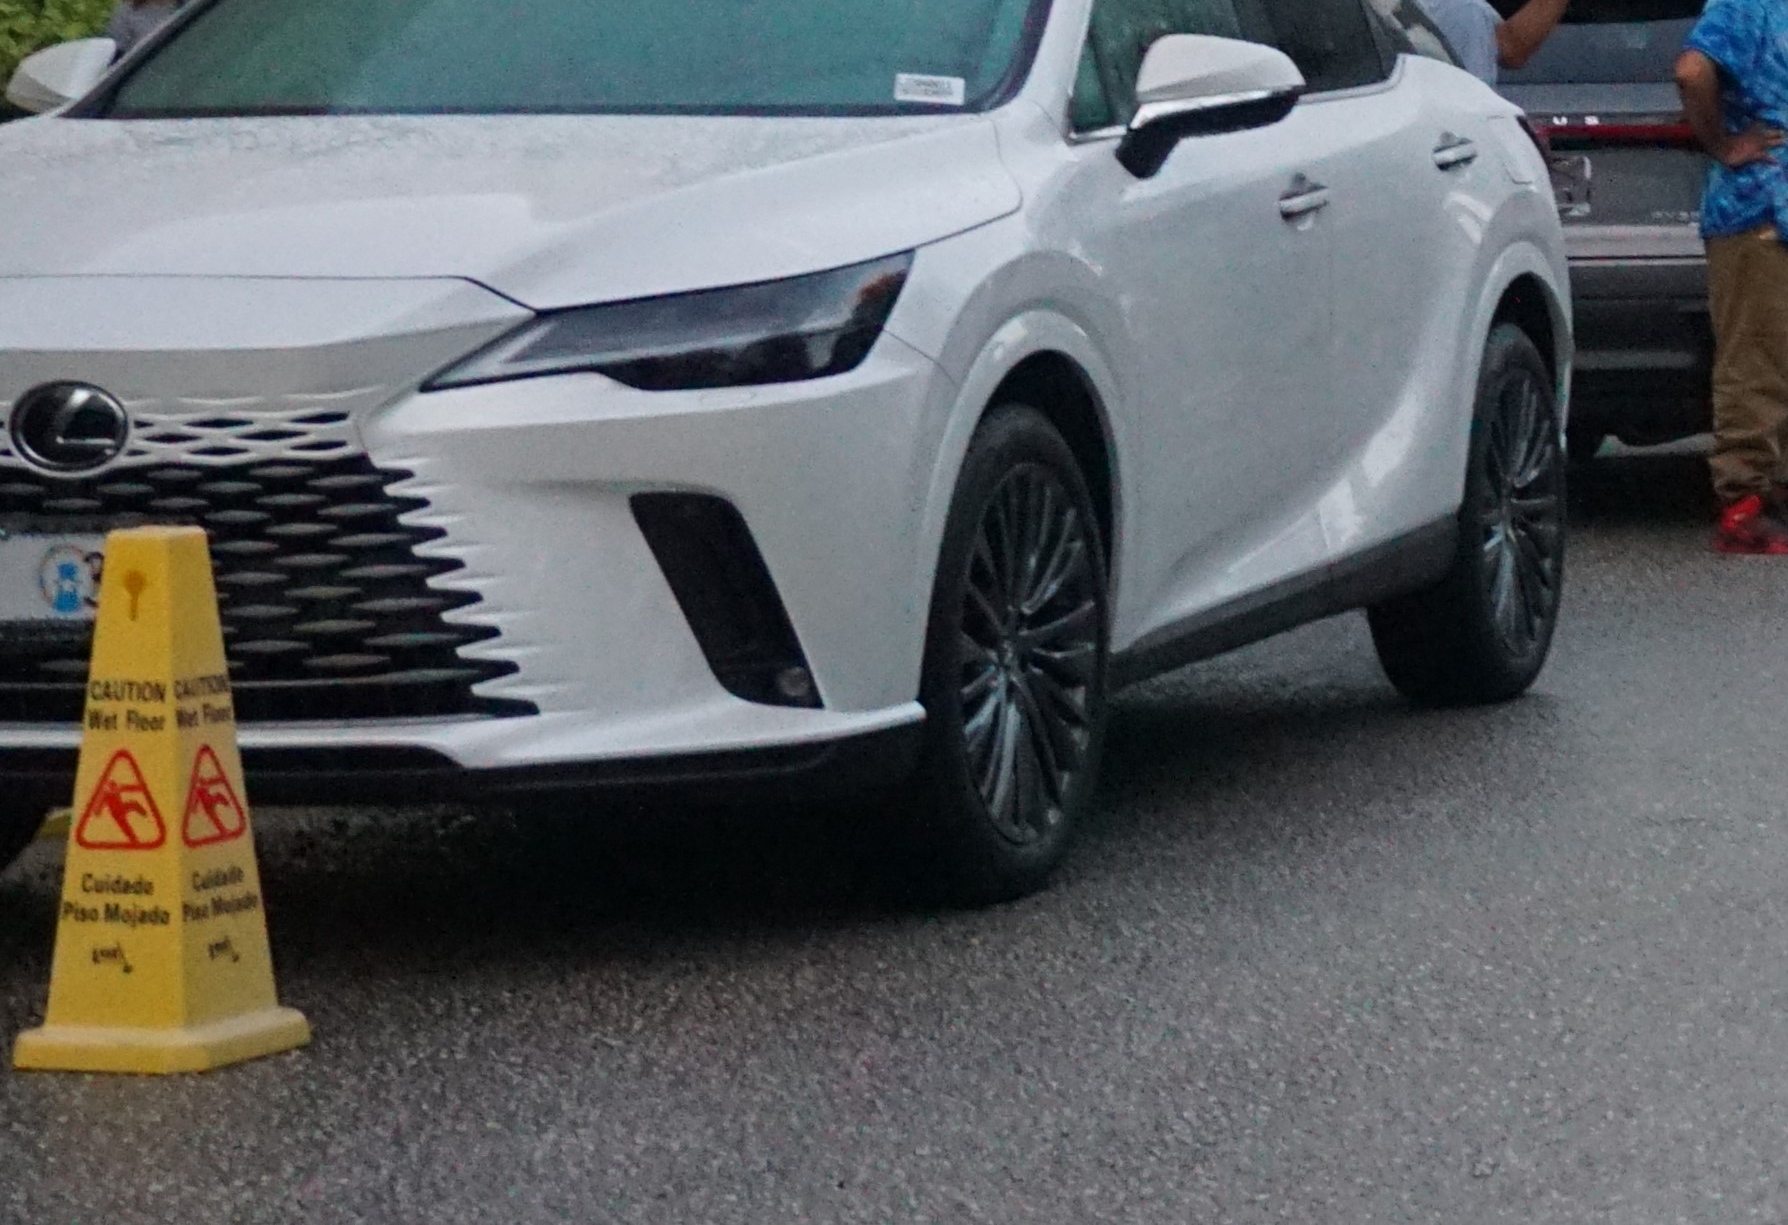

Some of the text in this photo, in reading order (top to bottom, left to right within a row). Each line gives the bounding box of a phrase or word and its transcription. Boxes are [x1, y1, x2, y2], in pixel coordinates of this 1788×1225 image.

[90, 679, 166, 704] CAUTION
[173, 674, 230, 700] CAUTION
[88, 709, 166, 732] Wet Floor
[81, 872, 154, 896] Cuidado
[62, 900, 170, 928] Piso Mojado
